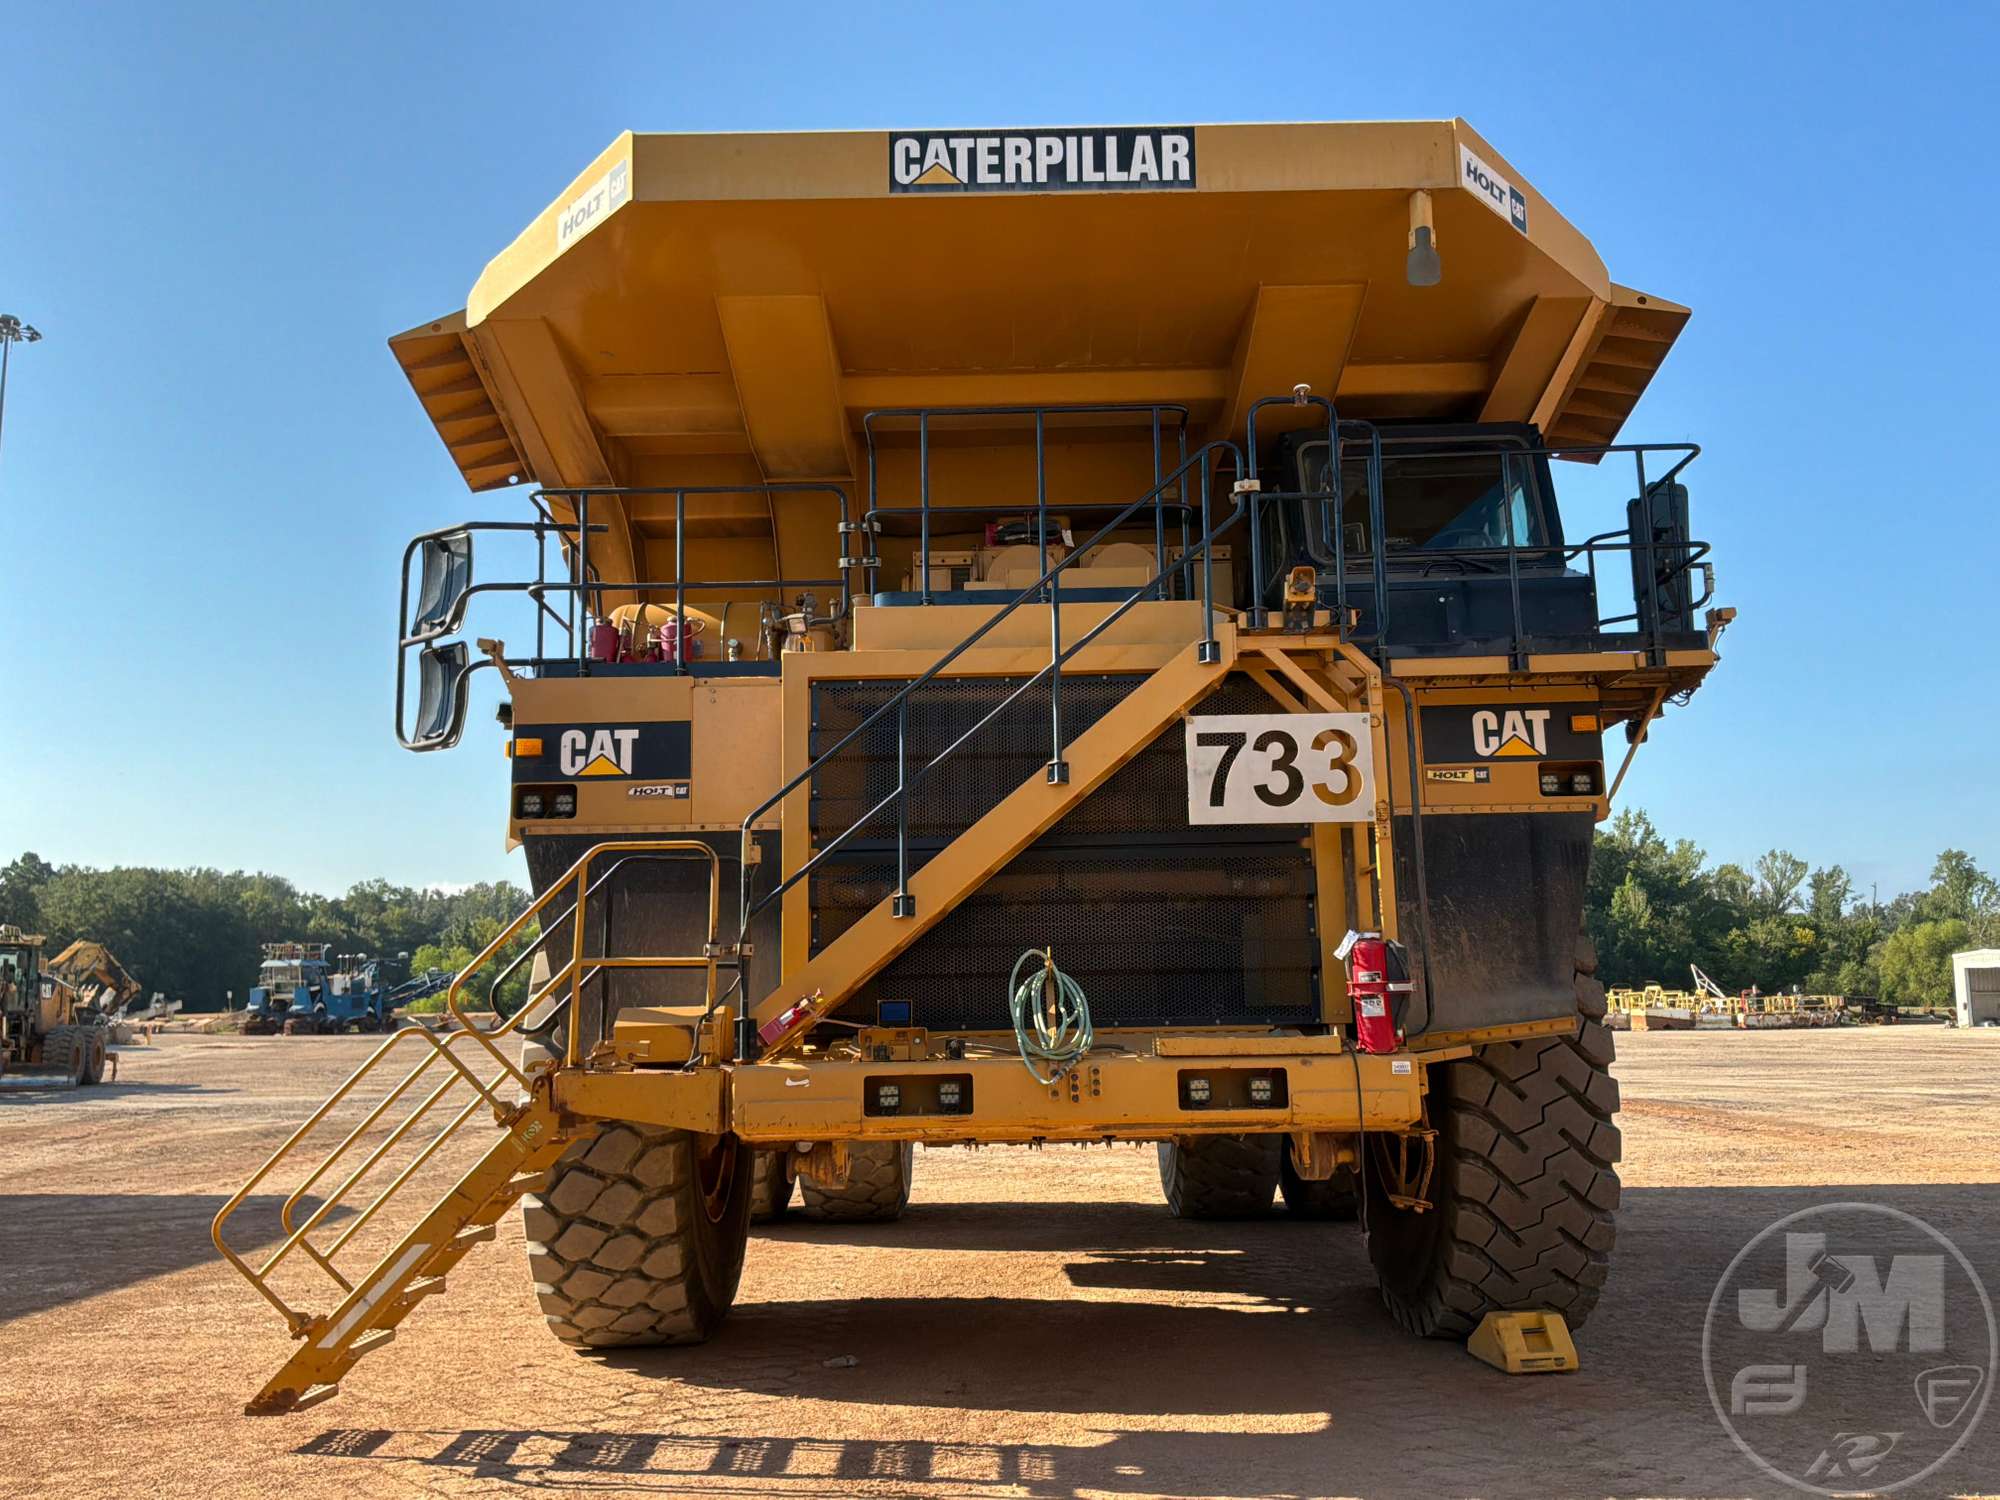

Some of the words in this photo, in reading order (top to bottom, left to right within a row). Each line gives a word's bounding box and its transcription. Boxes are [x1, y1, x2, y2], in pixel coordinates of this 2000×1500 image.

[894, 135, 1191, 185] CATERPILLAR
[1466, 160, 1506, 205] HOLT
[562, 189, 605, 239] HOLT
[560, 729, 640, 776] CAT
[1472, 709, 1551, 757] CAT
[633, 787, 669, 796] HOLT
[1196, 728, 1364, 808] 733
[1433, 771, 1469, 779] HOLT
